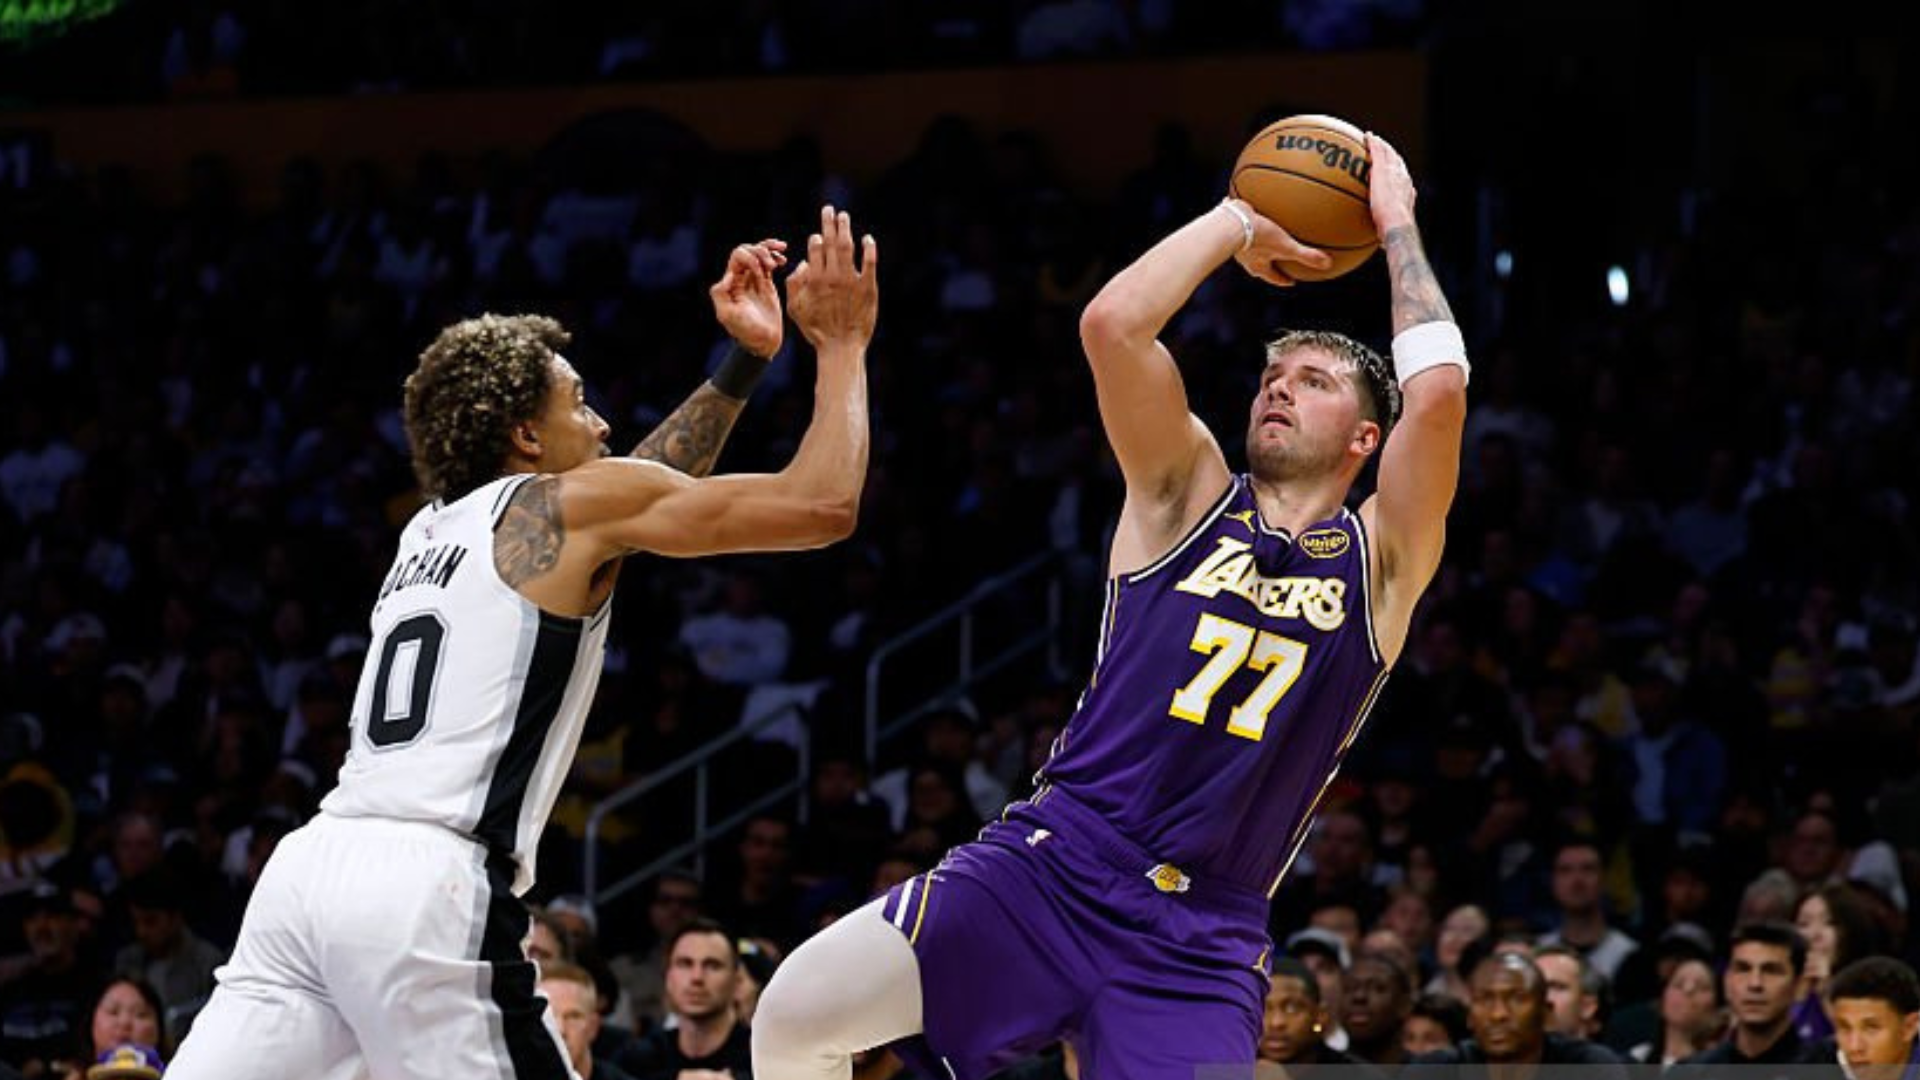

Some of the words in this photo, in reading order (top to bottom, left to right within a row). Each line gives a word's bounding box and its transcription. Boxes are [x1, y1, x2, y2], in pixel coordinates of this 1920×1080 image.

[377, 544, 468, 613] OCHAN
[349, 608, 451, 753] 0
[1168, 612, 1309, 742] 77
